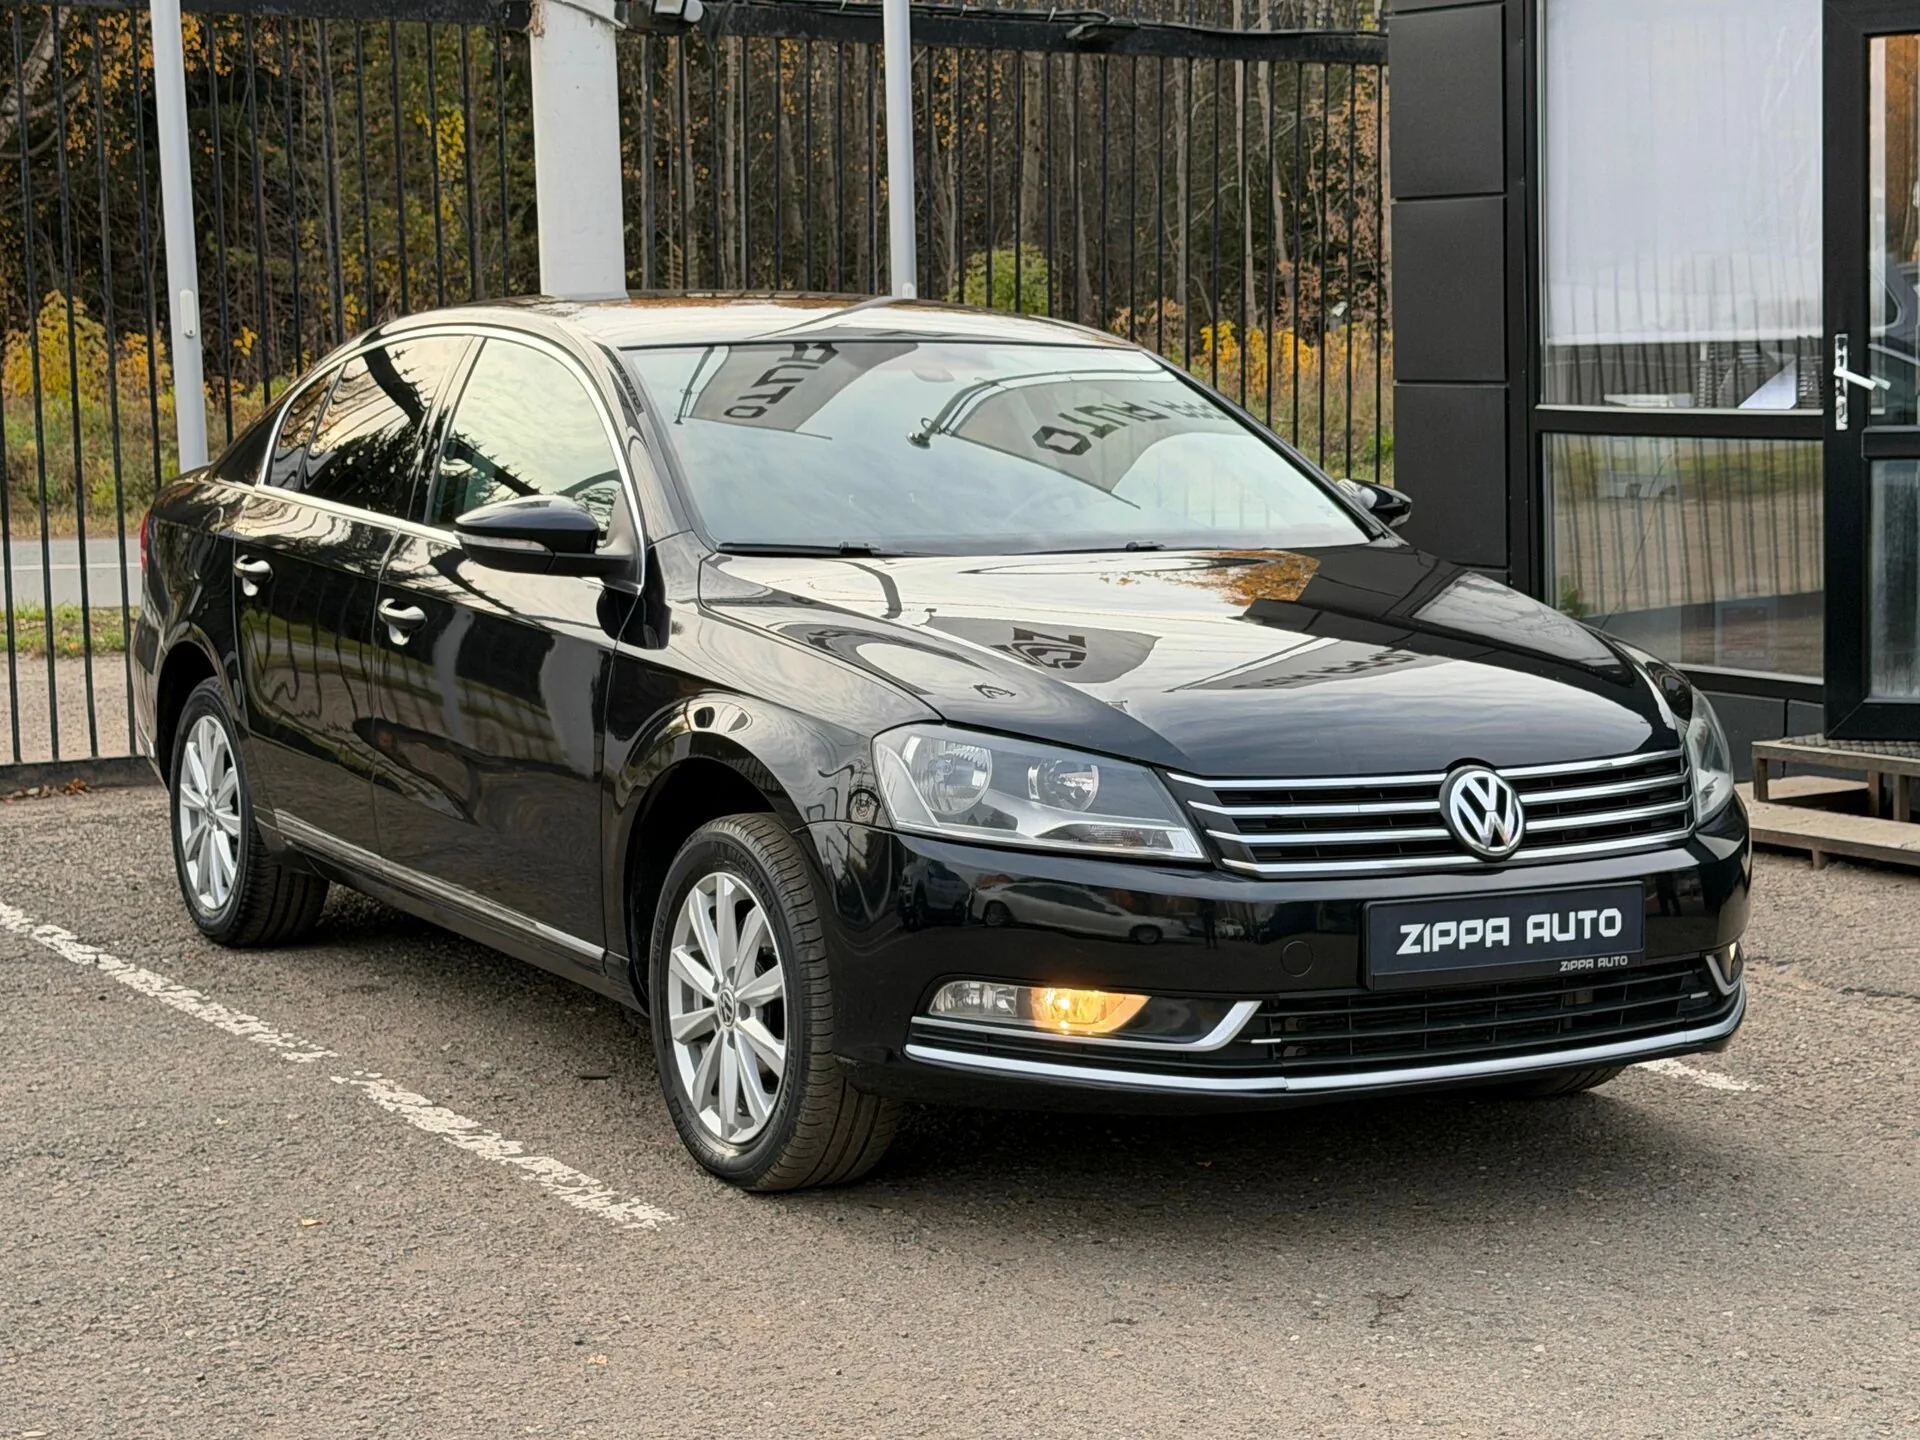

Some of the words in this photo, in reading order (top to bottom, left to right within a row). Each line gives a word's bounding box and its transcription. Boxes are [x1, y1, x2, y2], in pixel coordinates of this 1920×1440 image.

[1396, 916, 1510, 955] ZIPPA
[1526, 907, 1622, 944] AUTO
[1559, 958, 1594, 972] ZIPPA
[1597, 955, 1628, 969] AUTO
